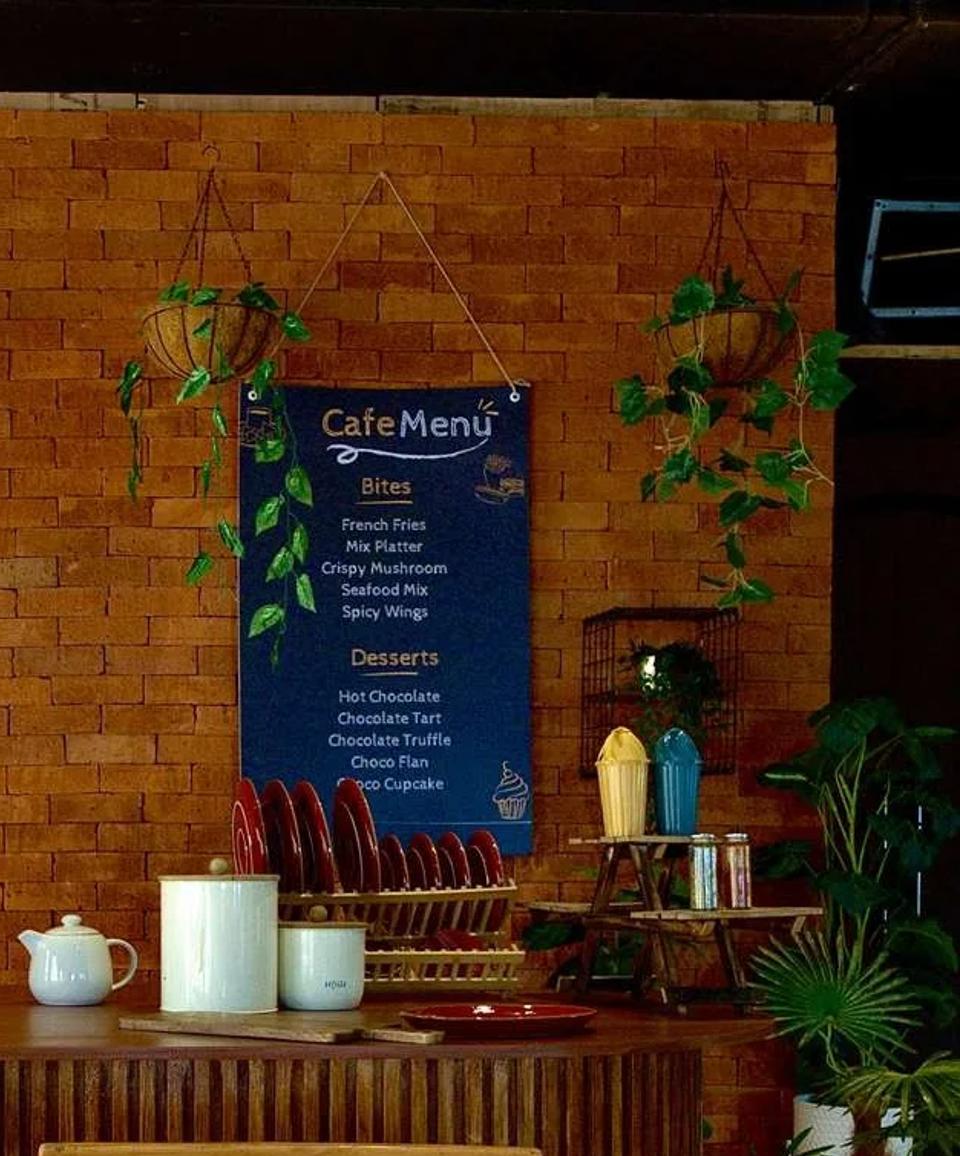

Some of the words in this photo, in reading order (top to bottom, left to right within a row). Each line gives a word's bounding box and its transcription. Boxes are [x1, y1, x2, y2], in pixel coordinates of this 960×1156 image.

[323, 408, 395, 436] Cafe
[400, 409, 492, 438] Menu
[362, 478, 411, 494] Bites
[342, 518, 388, 530] French
[393, 519, 426, 531] Fries
[347, 541, 370, 552] Mix
[376, 540, 423, 552] Platter
[322, 562, 366, 578] Crispy
[371, 562, 447, 575] Mushroom
[342, 583, 399, 596] Seafood
[404, 584, 428, 596] Mix
[343, 605, 380, 621] Spicy
[385, 606, 428, 621] Wings
[352, 649, 438, 666] Desserts
[339, 690, 366, 703] Hot
[369, 689, 440, 703] Chocolate
[338, 711, 409, 725] Chocolate
[412, 712, 441, 724] Tart
[329, 733, 399, 746] Chocolate
[403, 733, 451, 746] Truffle
[351, 756, 395, 768] Choco
[399, 755, 428, 768] Flan
[384, 777, 444, 793] Cupcake
